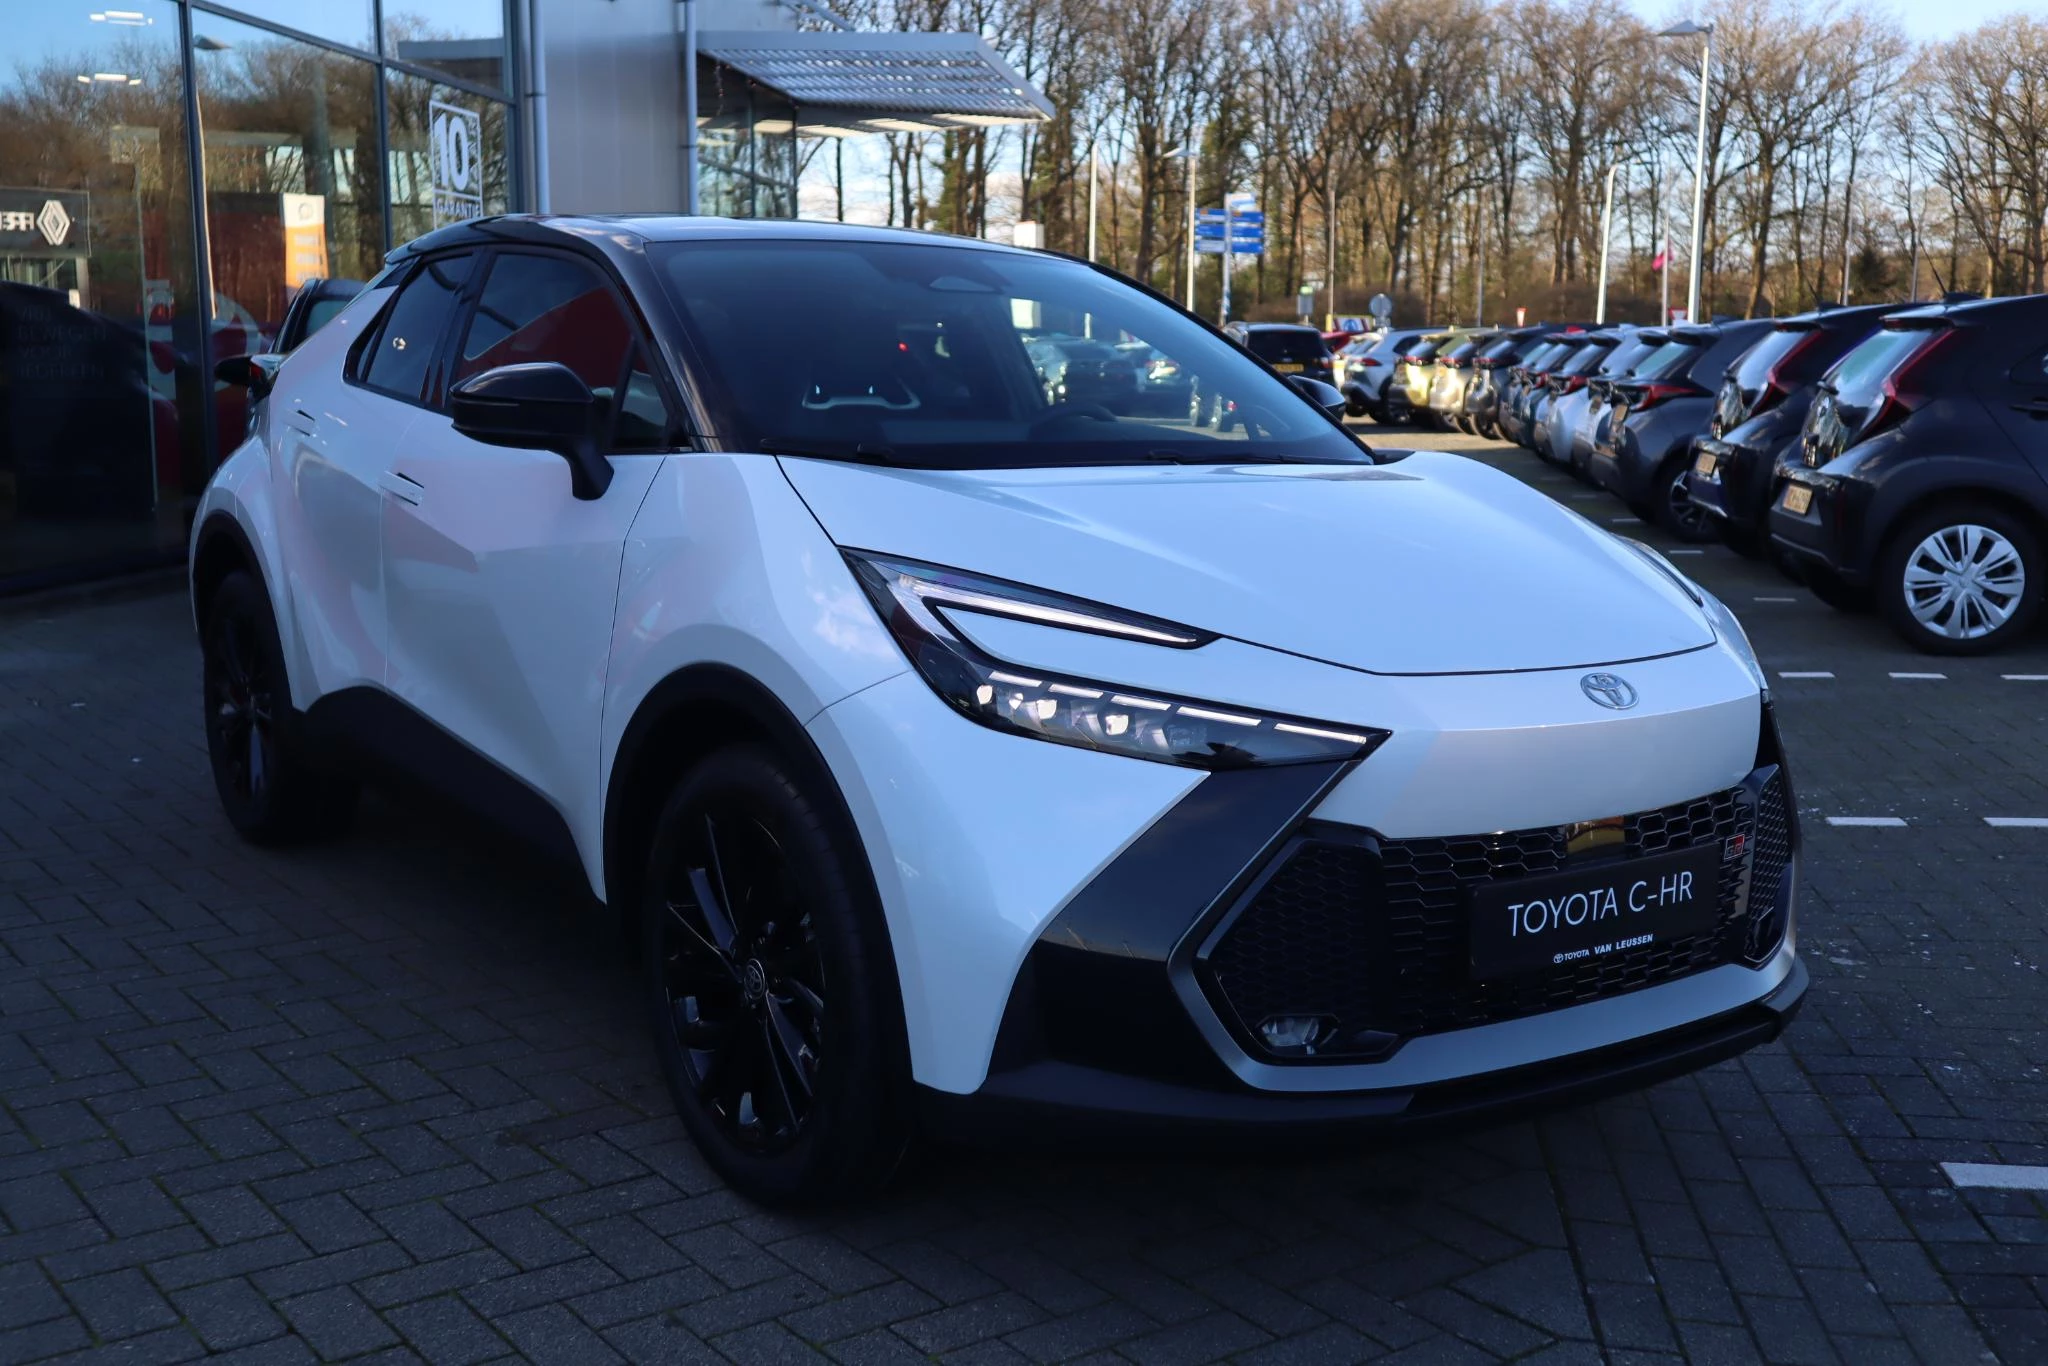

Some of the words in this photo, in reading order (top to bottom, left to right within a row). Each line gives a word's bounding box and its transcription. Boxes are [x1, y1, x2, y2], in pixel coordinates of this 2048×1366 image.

[433, 111, 470, 191] 10
[1507, 887, 1618, 937] TOYOTA
[1628, 871, 1693, 912] C-HR
[1564, 949, 1590, 961] TOYOTA
[1594, 943, 1612, 955] VAN
[1616, 933, 1654, 950] LEUSSEN
